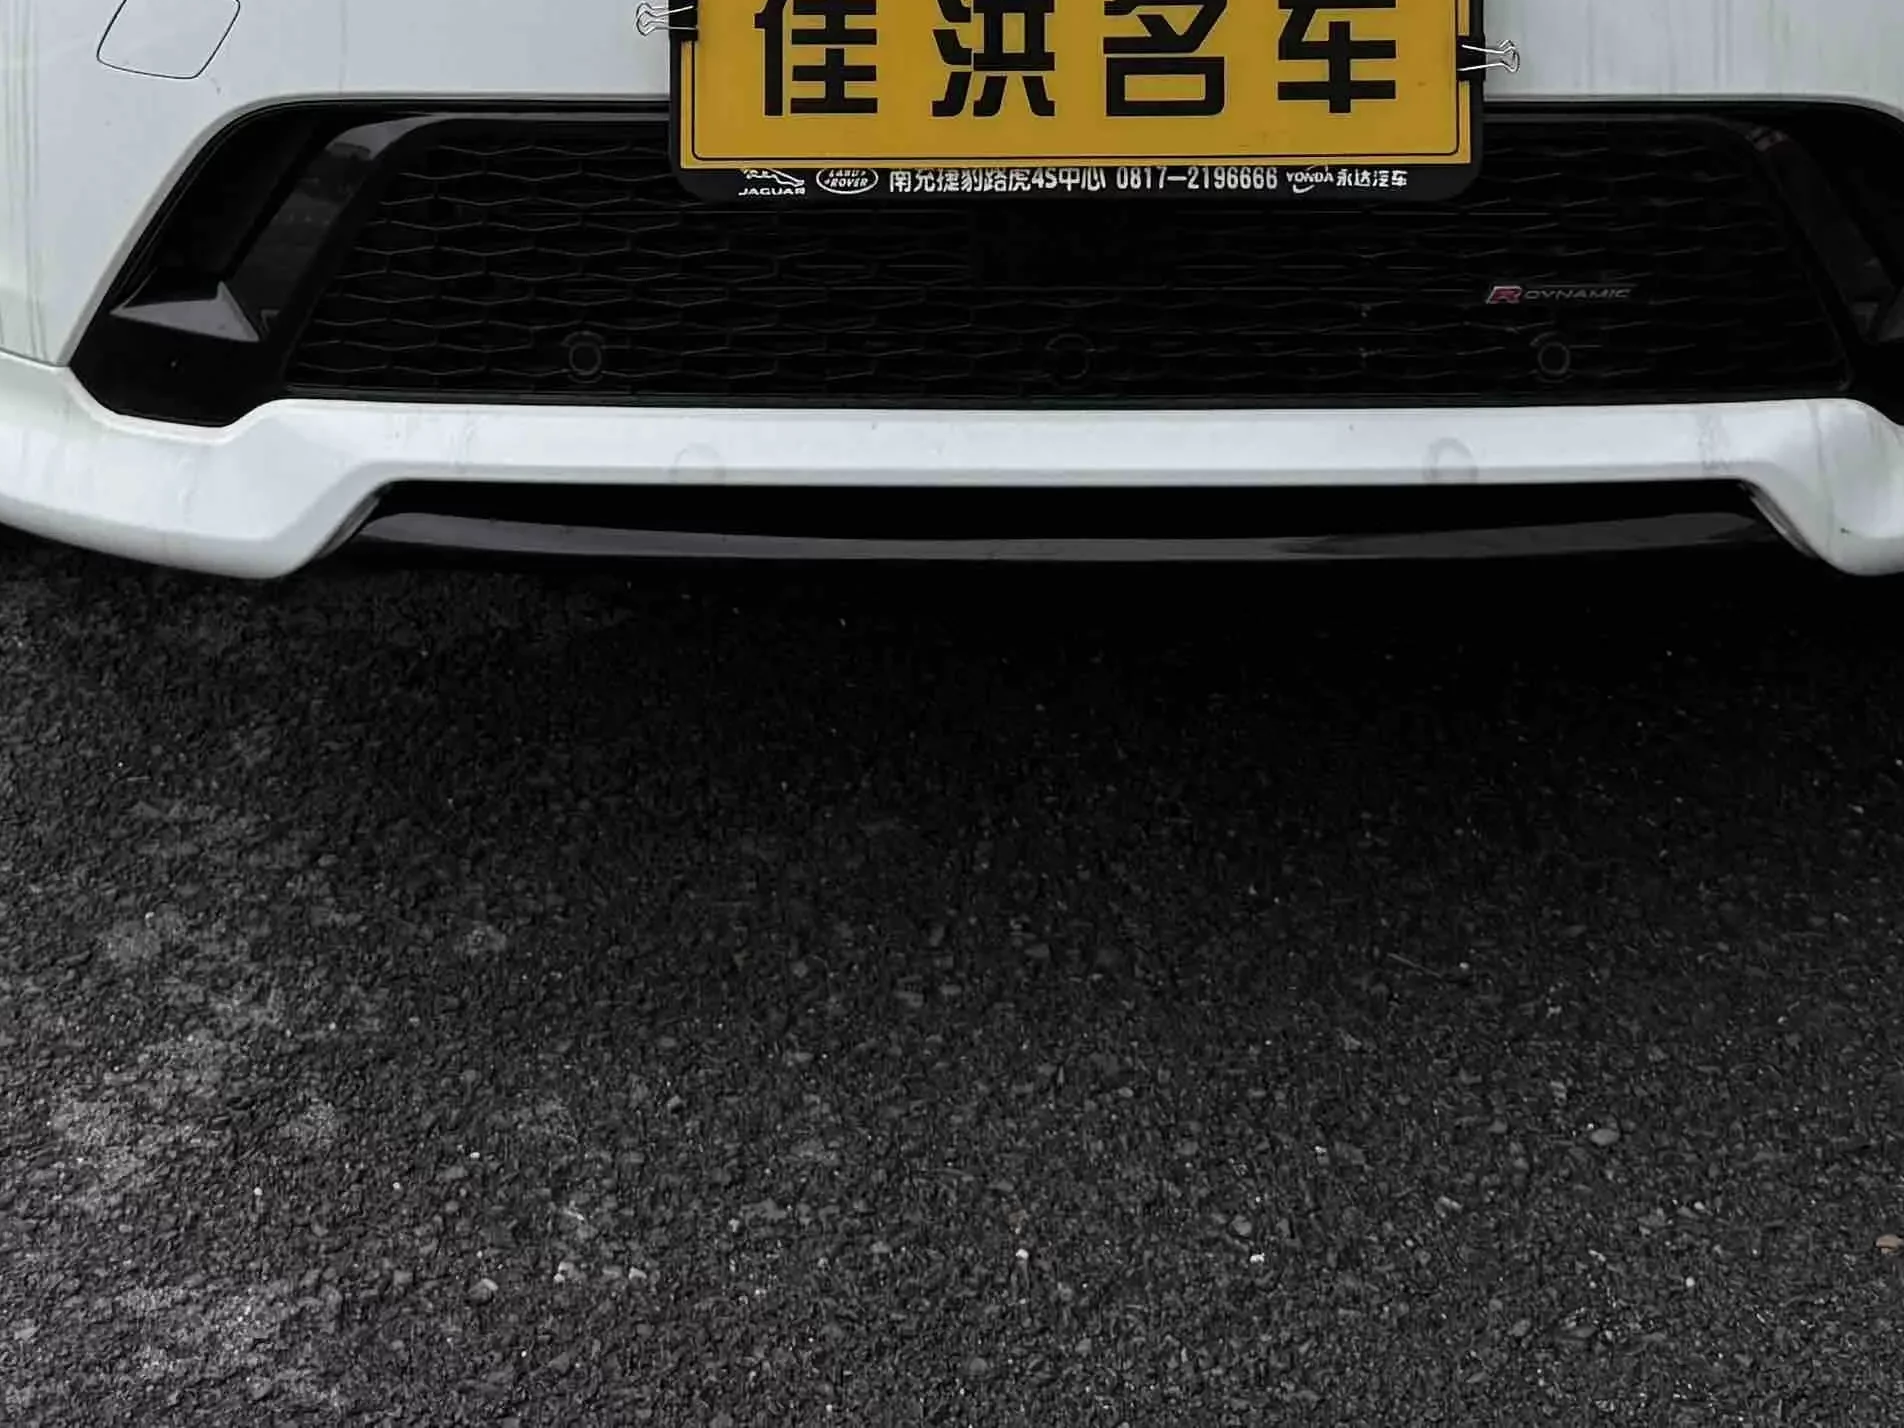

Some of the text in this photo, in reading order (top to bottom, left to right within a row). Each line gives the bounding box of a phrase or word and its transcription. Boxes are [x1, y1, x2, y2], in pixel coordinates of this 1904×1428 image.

[829, 177, 869, 188] ROVER
[889, 166, 1278, 193] 南充捷豹路虎4S中心 0817-2196666
[1336, 168, 1408, 188] 永达汽车
[738, 187, 806, 196] JAGUAR
[1486, 285, 1523, 304] R
